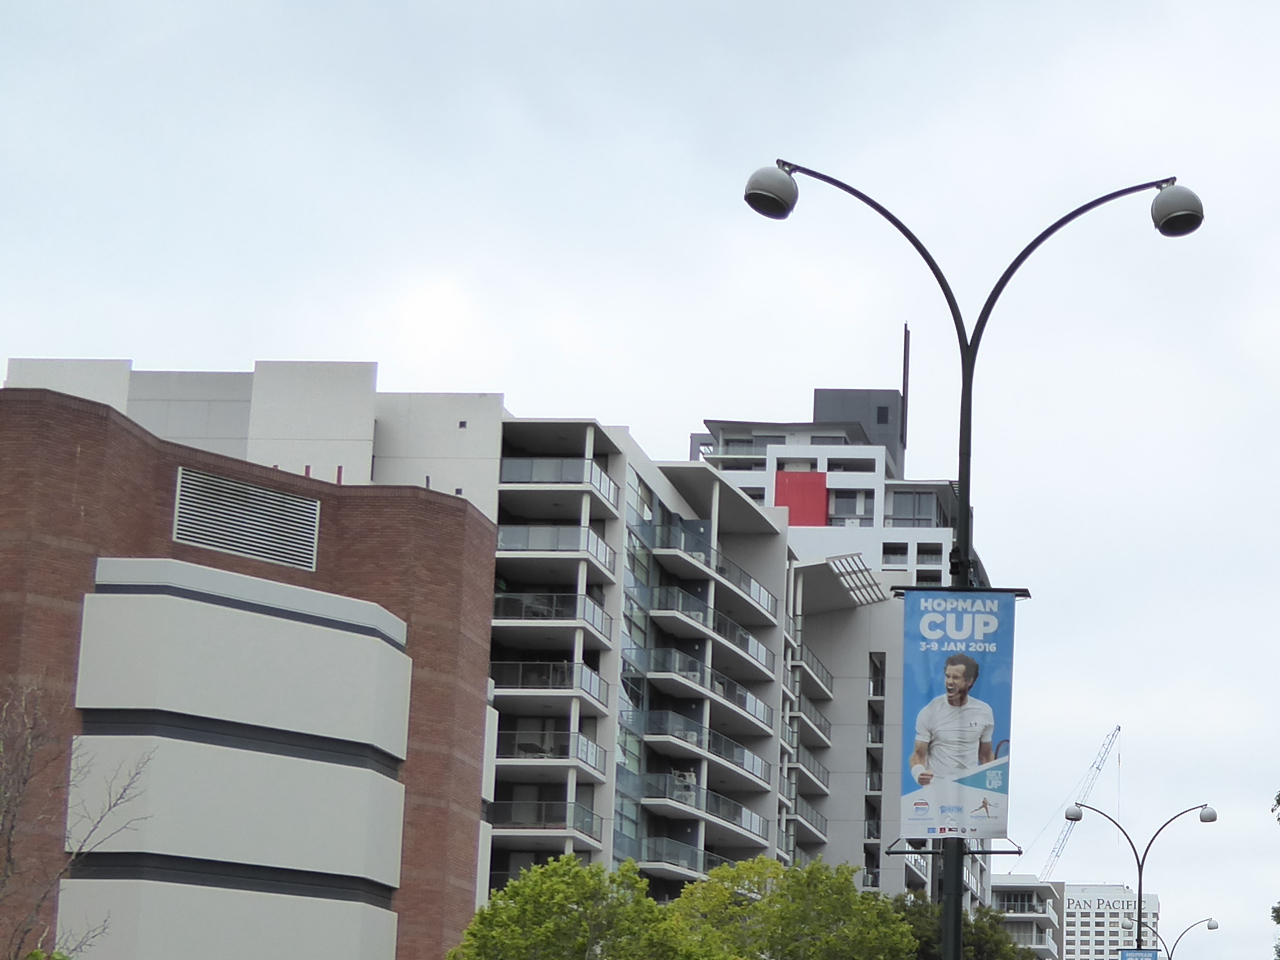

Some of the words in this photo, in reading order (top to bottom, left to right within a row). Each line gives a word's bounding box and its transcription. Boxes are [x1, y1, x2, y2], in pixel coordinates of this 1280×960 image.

[920, 598, 999, 612] HOPMAN
[919, 612, 999, 640] CUP
[920, 641, 939, 651] 3-9
[941, 642, 966, 652] JAN
[968, 642, 997, 652] 2016
[986, 779, 1003, 789] UP
[1067, 898, 1092, 910] PAN
